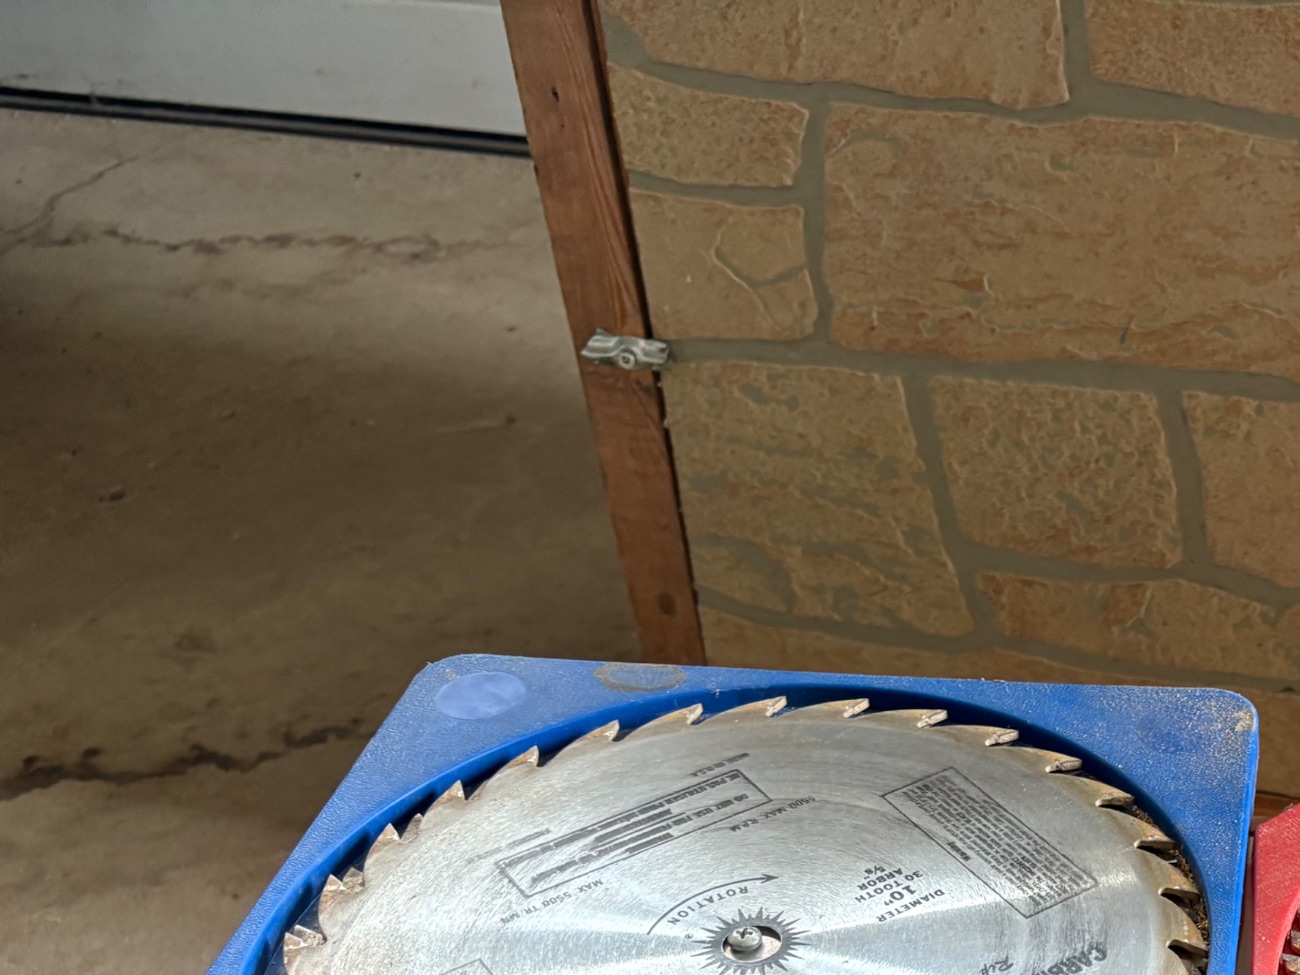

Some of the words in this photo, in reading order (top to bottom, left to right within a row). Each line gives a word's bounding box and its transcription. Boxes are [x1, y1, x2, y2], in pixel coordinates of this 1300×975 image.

[855, 866, 905, 892] ARBOR
[902, 869, 924, 882] 30
[539, 891, 572, 908] 5500
[661, 882, 752, 926] ROTATION
[853, 878, 904, 904] TOOTH
[875, 887, 945, 923] DIAMETER
